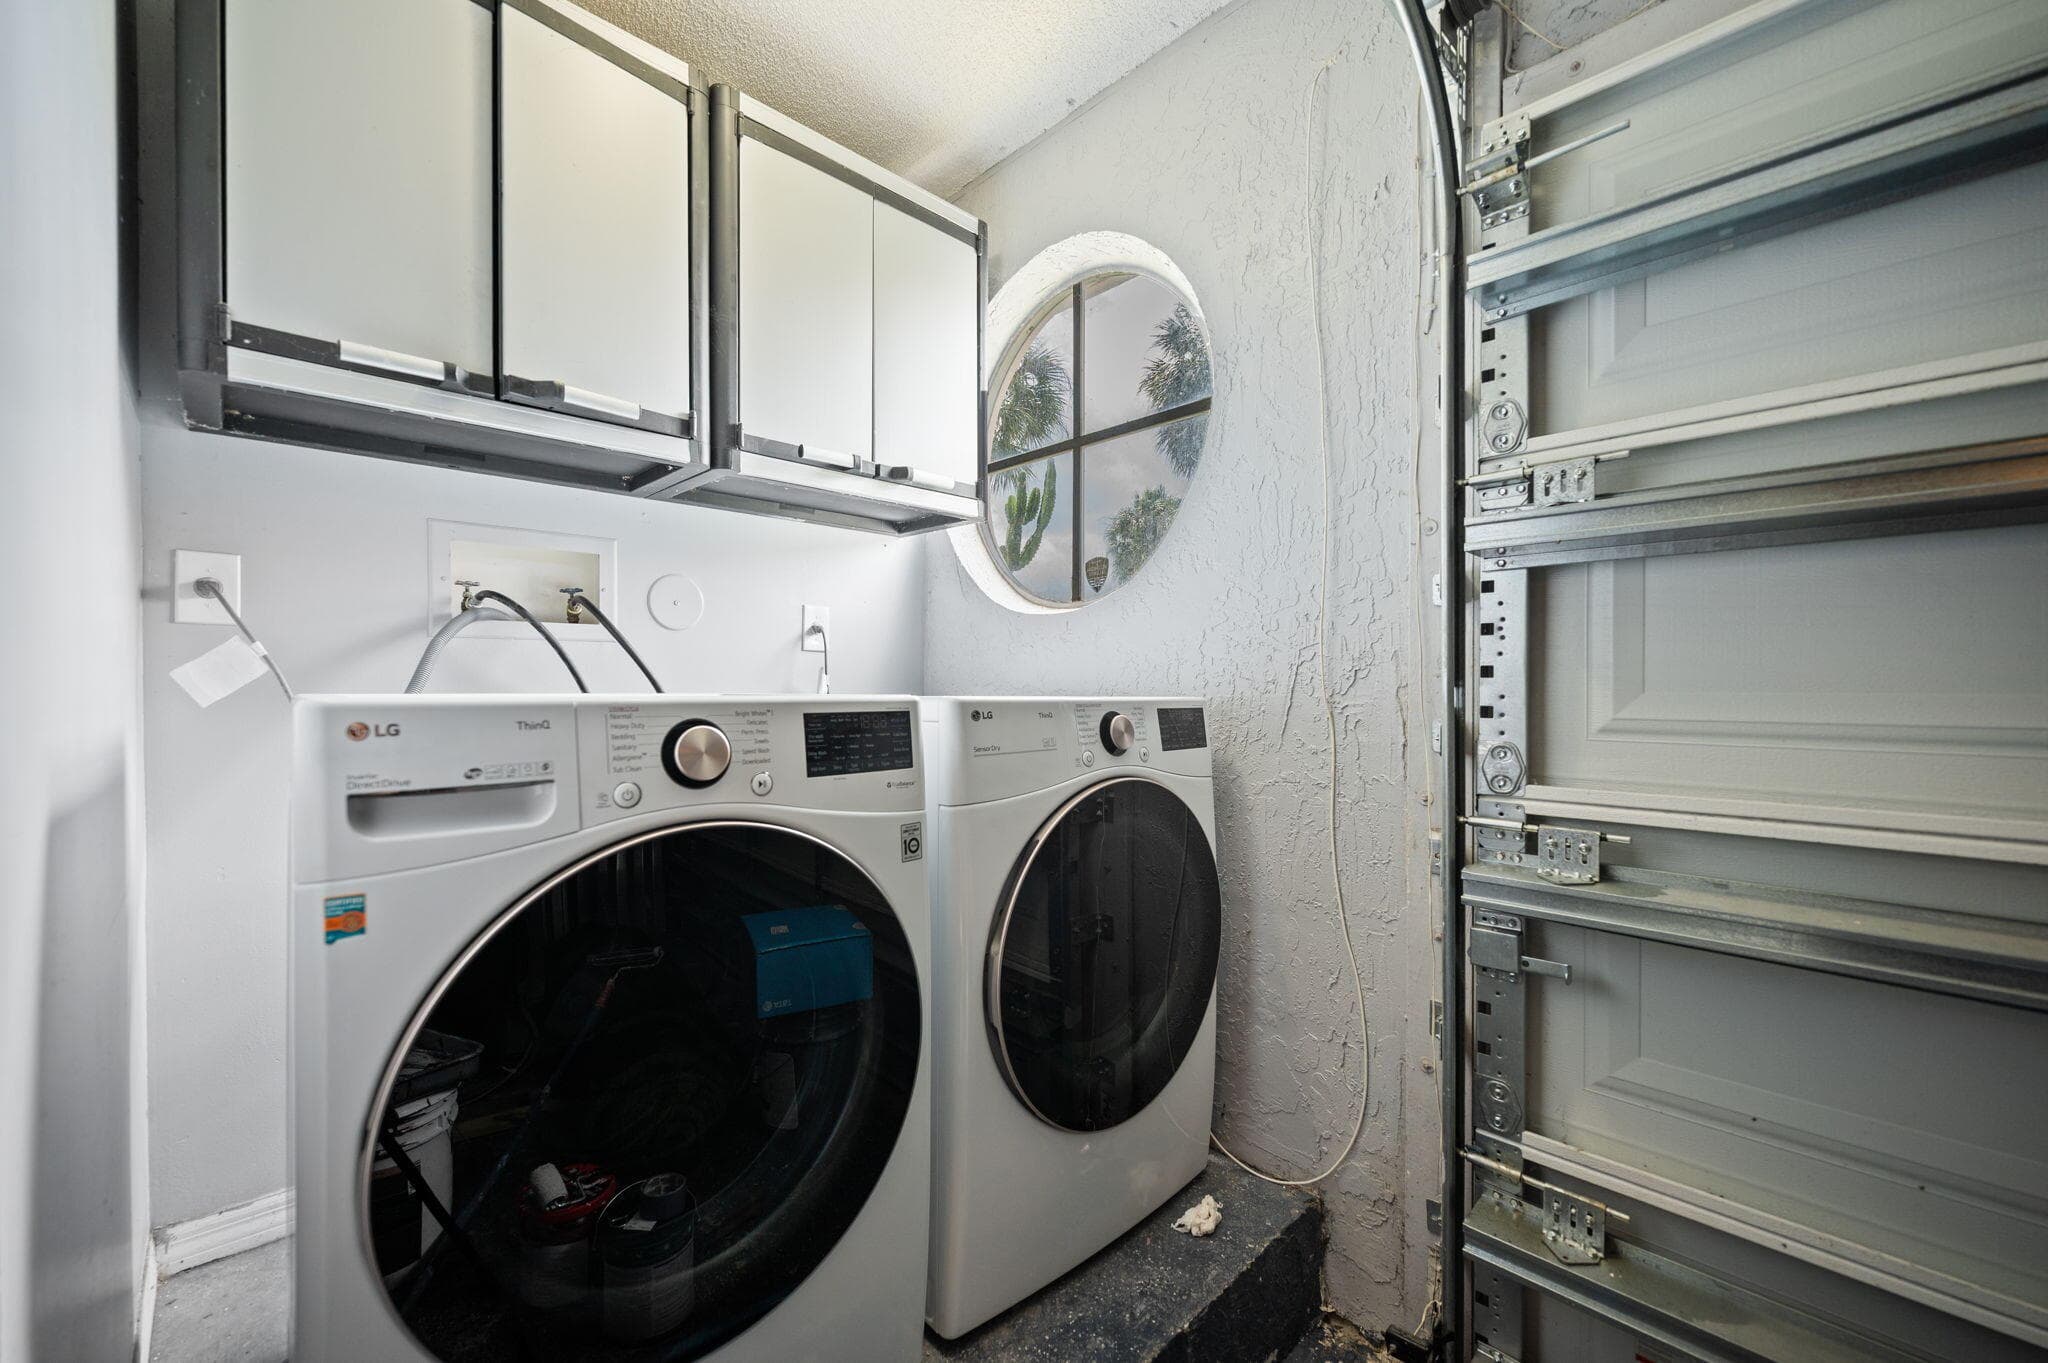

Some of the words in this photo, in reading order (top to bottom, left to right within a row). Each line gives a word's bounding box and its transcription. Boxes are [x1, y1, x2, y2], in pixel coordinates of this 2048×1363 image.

[982, 711, 993, 719] LG
[374, 723, 401, 737] LG
[515, 719, 551, 730] ThinQ
[631, 722, 645, 730] Duty
[904, 838, 920, 855] 10
